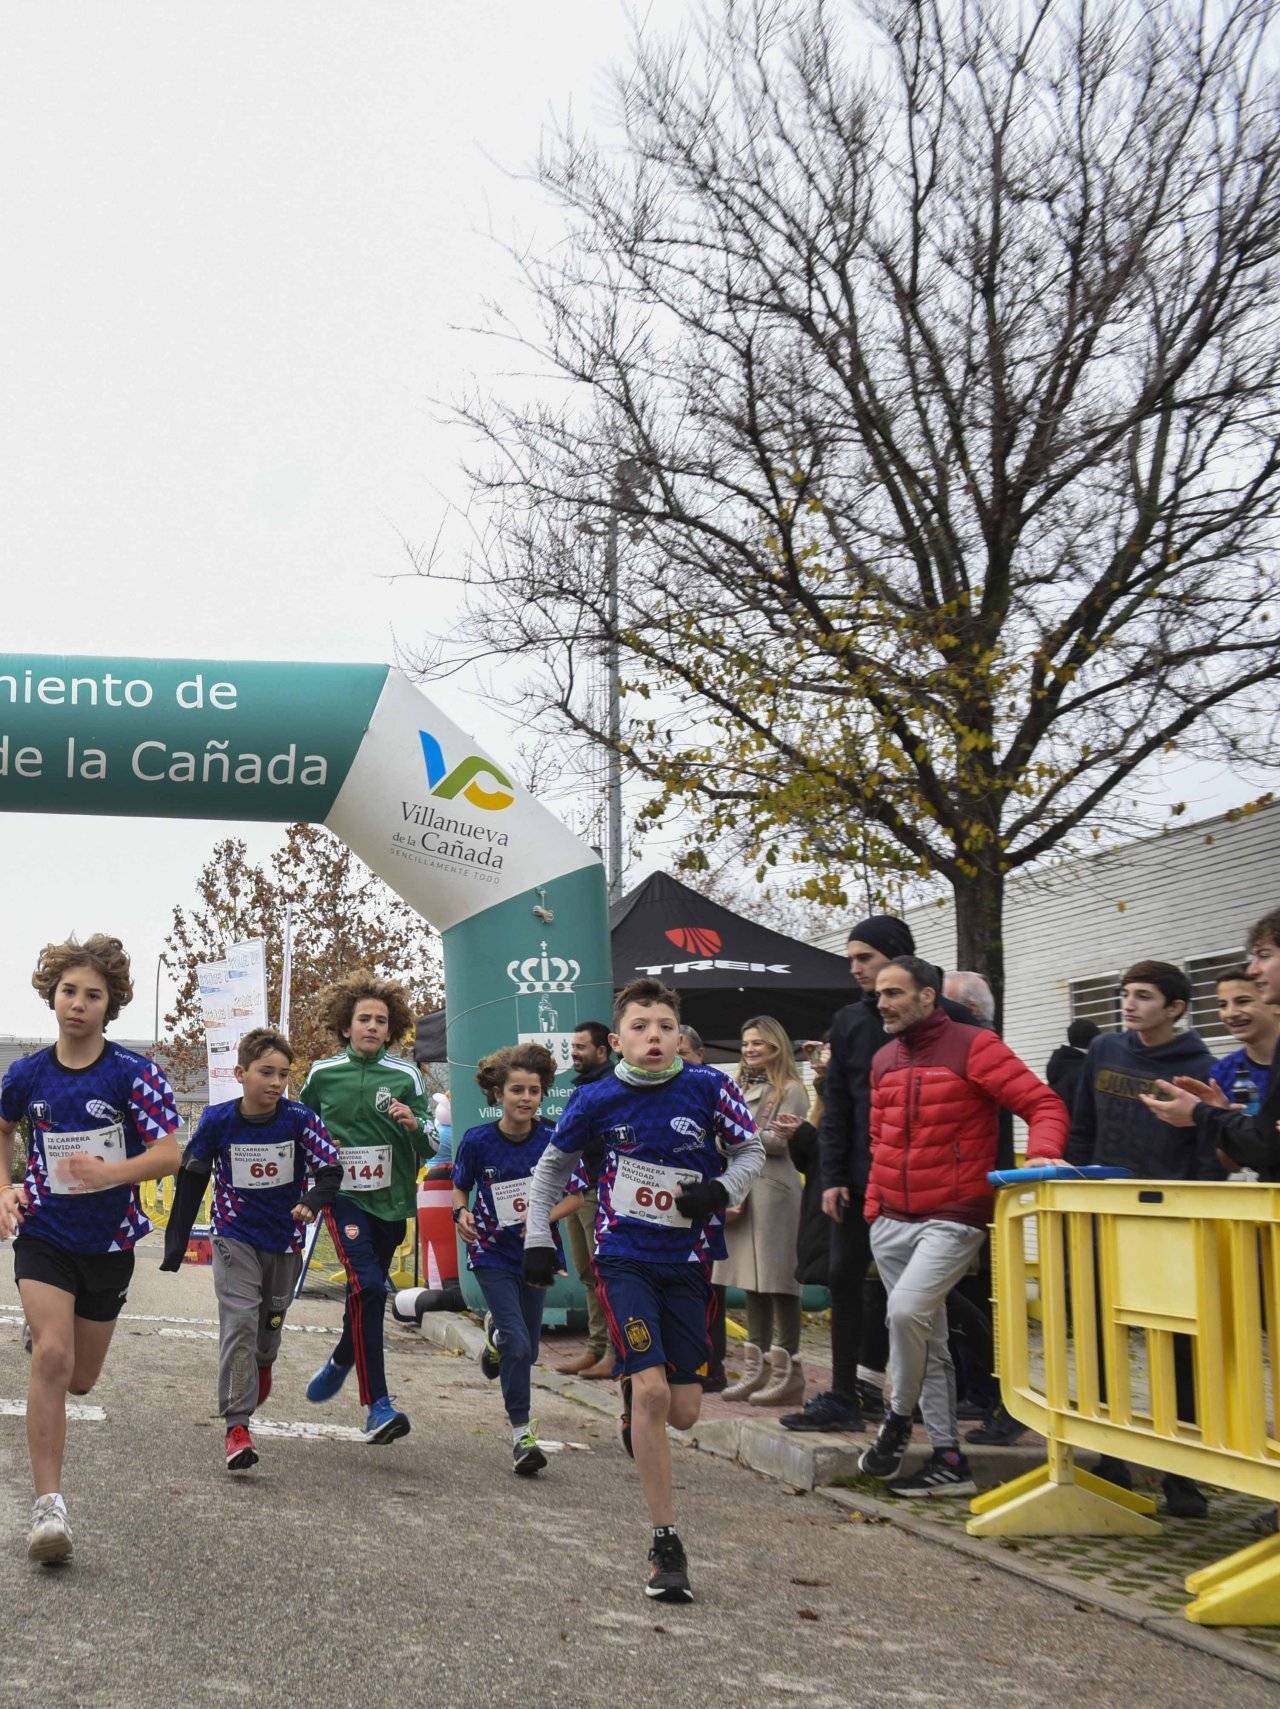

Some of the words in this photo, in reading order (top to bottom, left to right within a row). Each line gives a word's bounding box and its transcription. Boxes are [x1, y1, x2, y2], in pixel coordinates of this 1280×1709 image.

[175, 674, 237, 710] de
[67, 737, 108, 780] la
[131, 740, 329, 786] Cañada
[401, 801, 509, 847] Villanueva
[392, 832, 406, 843] de
[407, 835, 416, 847] la
[421, 831, 504, 869] Cañada
[390, 848, 469, 876] SENCILLAMENTE
[474, 871, 500, 885] TODO
[635, 960, 792, 975] TREK
[250, 1162, 278, 1179] 66
[348, 1164, 384, 1180] 144
[621, 1166, 654, 1180] NAVIDAD
[632, 1162, 666, 1176] CARRERA
[502, 1182, 527, 1190] CARRERA
[621, 1172, 660, 1188] SOLIDARIA
[513, 1198, 529, 1212] 6
[636, 1187, 673, 1211] 60
